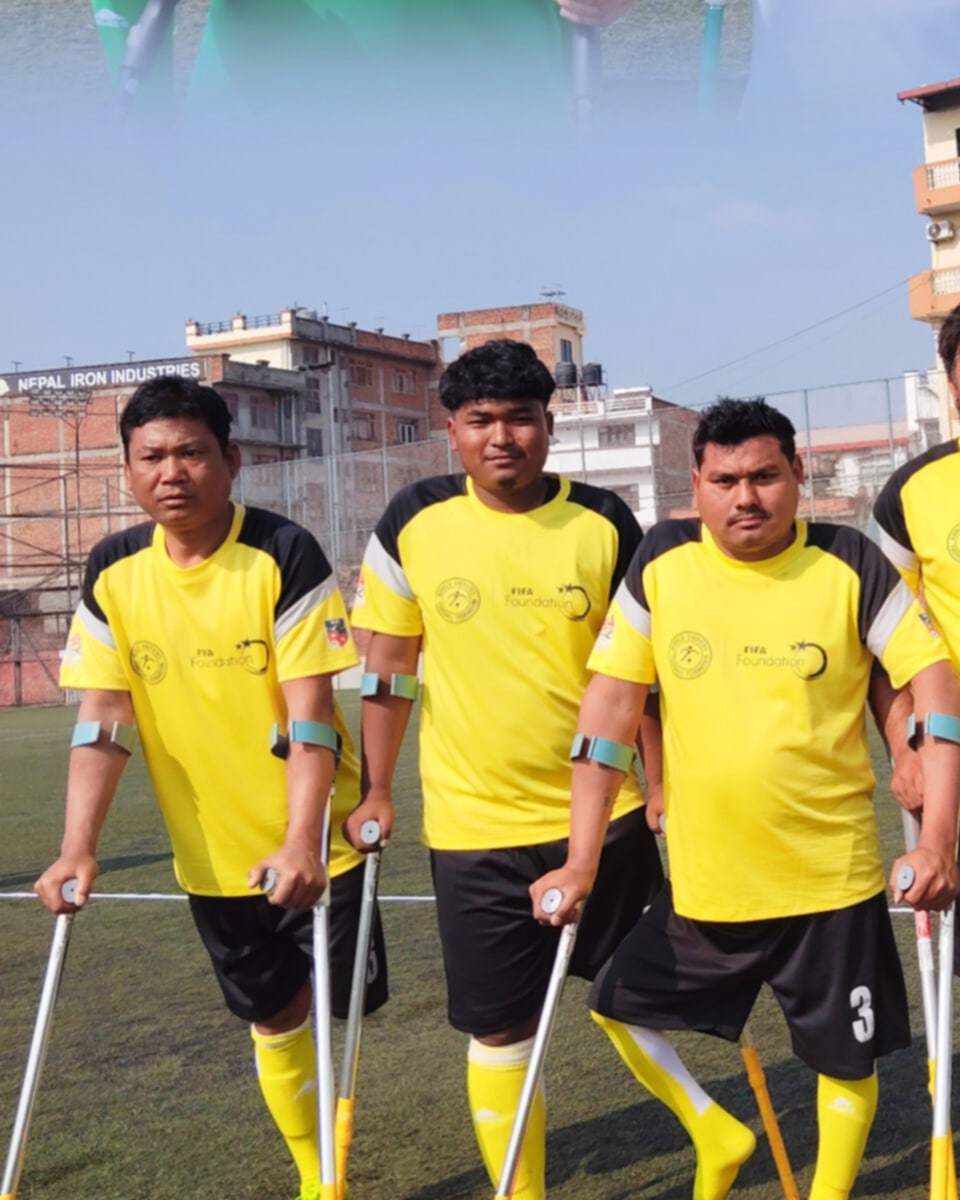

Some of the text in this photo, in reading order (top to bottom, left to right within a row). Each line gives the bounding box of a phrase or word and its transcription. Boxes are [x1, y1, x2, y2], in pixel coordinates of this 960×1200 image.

[18, 362, 201, 392] NEPAL IRON INDUSTRIES
[511, 587, 534, 596] FIFA
[504, 595, 574, 609] Foundation
[744, 646, 767, 655] FIFA
[736, 654, 806, 668] Foundation
[849, 985, 875, 1043] 3
